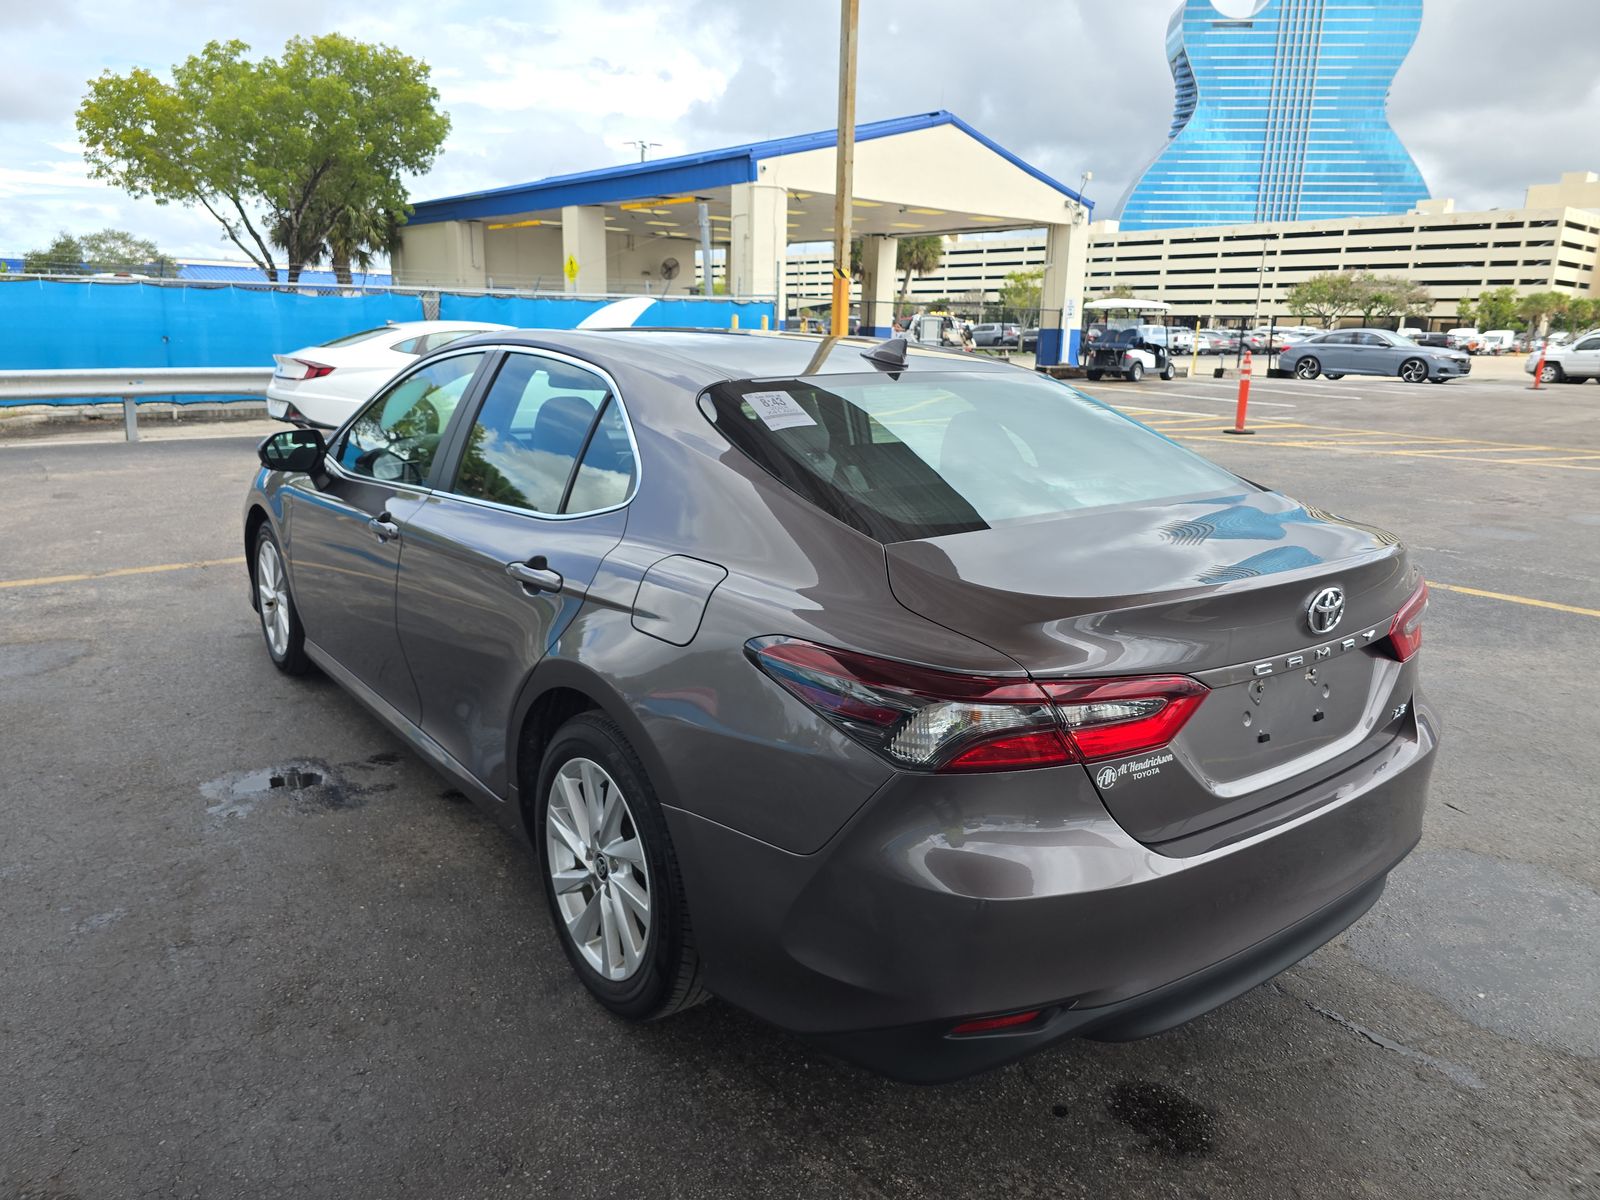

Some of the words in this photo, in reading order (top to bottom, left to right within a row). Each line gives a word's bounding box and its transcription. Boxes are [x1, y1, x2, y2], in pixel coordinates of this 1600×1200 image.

[1253, 629, 1376, 676] CAMRY
[1129, 753, 1173, 772] Hendrickson
[1132, 767, 1160, 780] TOYOTA
